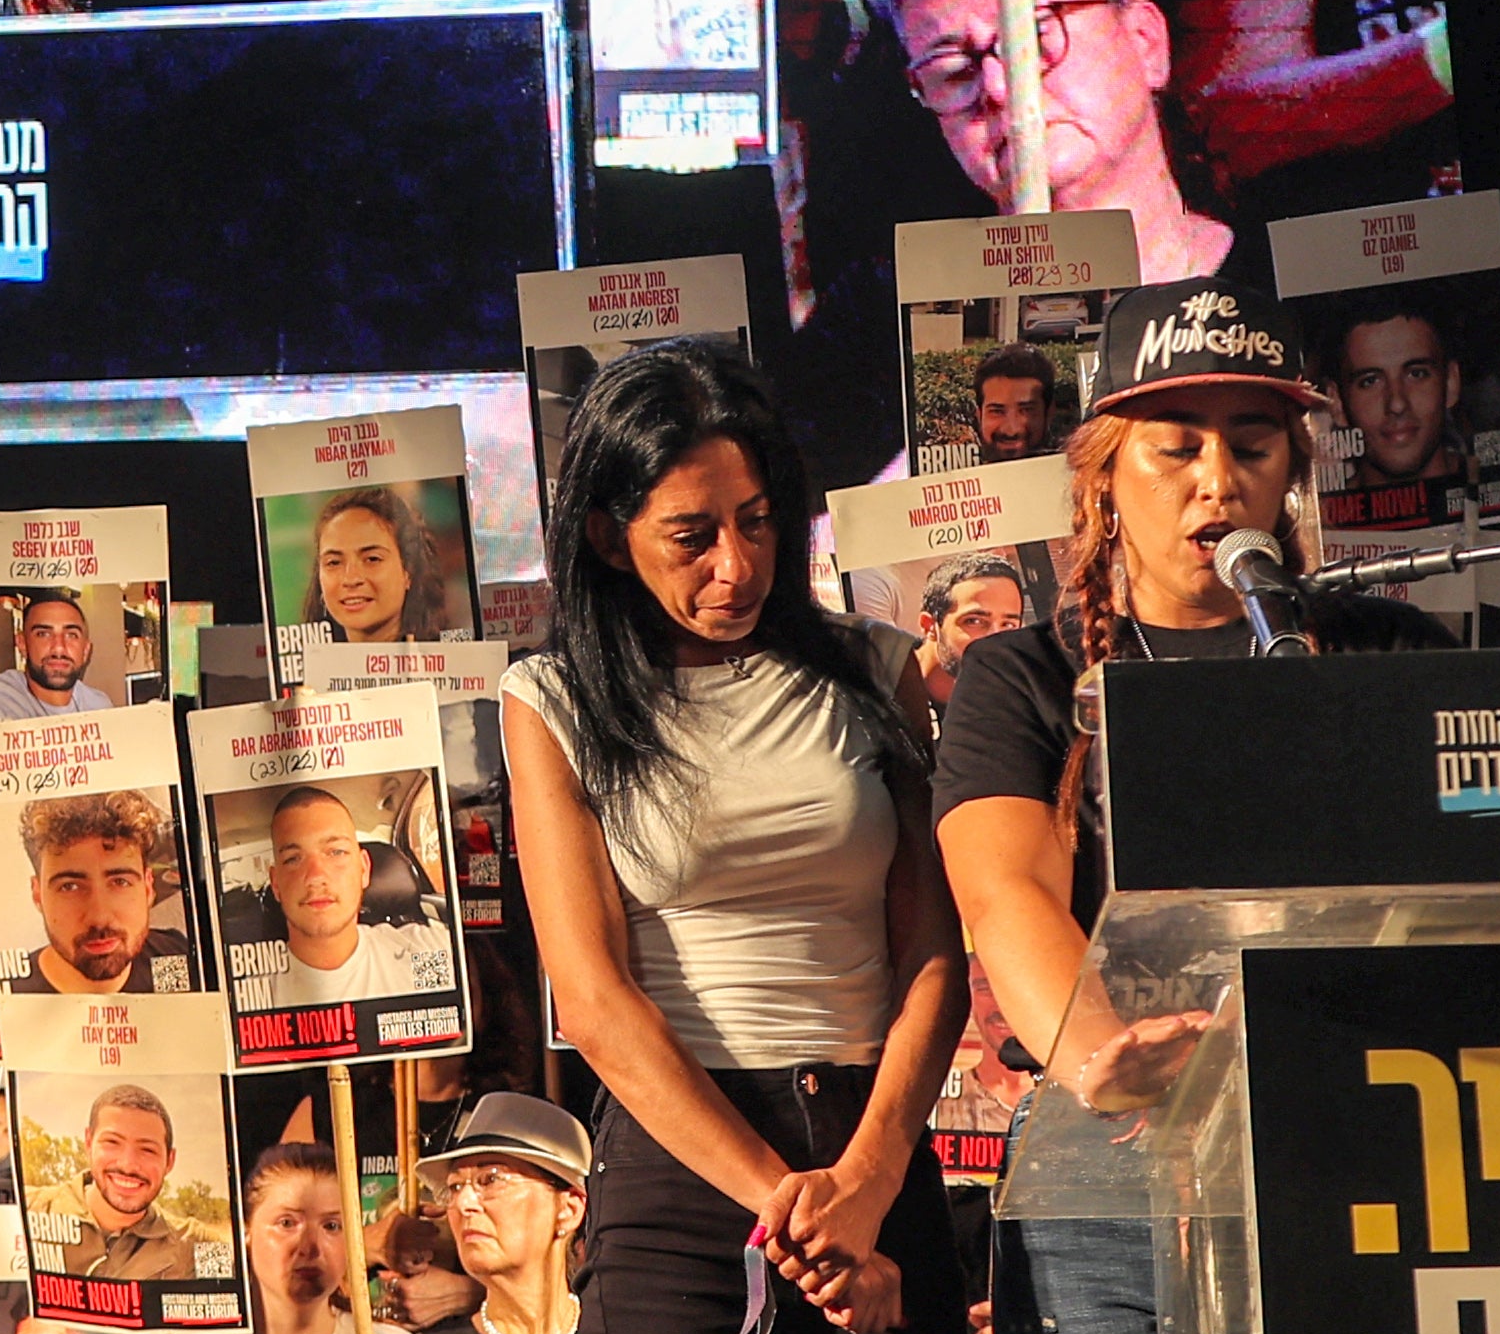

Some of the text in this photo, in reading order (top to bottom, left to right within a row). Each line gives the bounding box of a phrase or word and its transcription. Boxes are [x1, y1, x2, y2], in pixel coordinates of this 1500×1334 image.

[1023, 226, 1049, 246] עידן
[1388, 232, 1420, 257] DANIEL
[983, 245, 1055, 267] IDAN SHTIVI
[587, 288, 680, 312] MATAN ANGREST
[327, 423, 380, 445] ענבר הימן
[314, 439, 396, 462] INBAR HAYMAN
[922, 477, 981, 503] נמרוד כהן
[908, 496, 1003, 529] NIMROD COHEN
[24, 521, 80, 542] שגב כלפון
[12, 538, 94, 558] SEGEV KALFON
[272, 702, 351, 730] בר קופרשטיין
[3, 721, 102, 751] גיא גלבוע-דלאל
[231, 718, 403, 757] BAR ABRAHAM KUPERSHTEIN
[23, 741, 114, 768] GILBOA-DALAL
[230, 941, 290, 979] BRING
[234, 979, 274, 1013] HIM
[89, 1005, 129, 1025] איתי חן
[239, 1004, 356, 1048] HOME NOW!
[82, 1025, 138, 1045] ITAY CHEN
[27, 1211, 81, 1246] BRING
[32, 1244, 68, 1275] HIM
[36, 1275, 142, 1316] HOME NOW!
